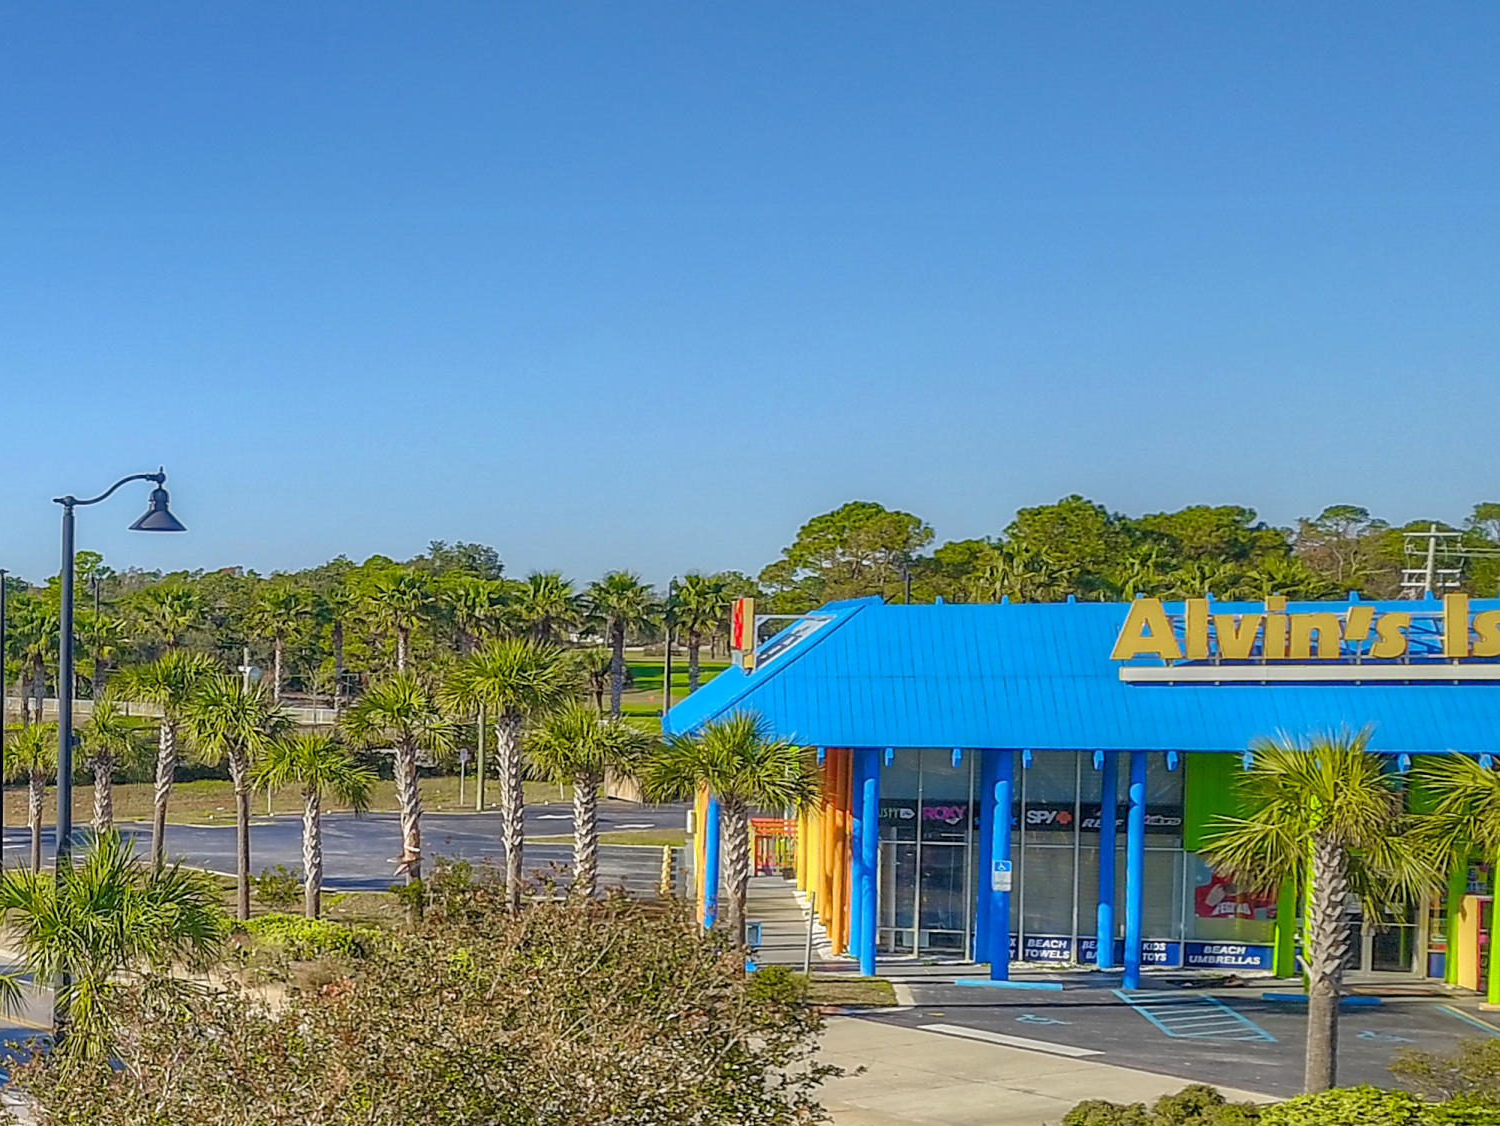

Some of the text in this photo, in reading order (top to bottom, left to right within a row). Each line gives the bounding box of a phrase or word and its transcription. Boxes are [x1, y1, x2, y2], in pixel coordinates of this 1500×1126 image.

[1110, 595, 1411, 660] Alvin's
[922, 806, 968, 821] ROXY
[1026, 810, 1057, 825] SPY
[1027, 939, 1068, 950] BEACH
[1142, 942, 1167, 952] KIDS
[1203, 945, 1247, 955] BEACH
[1024, 948, 1071, 960] TOWELS
[1142, 952, 1167, 963] TOYS
[1188, 955, 1261, 966] UMBRELLAS
